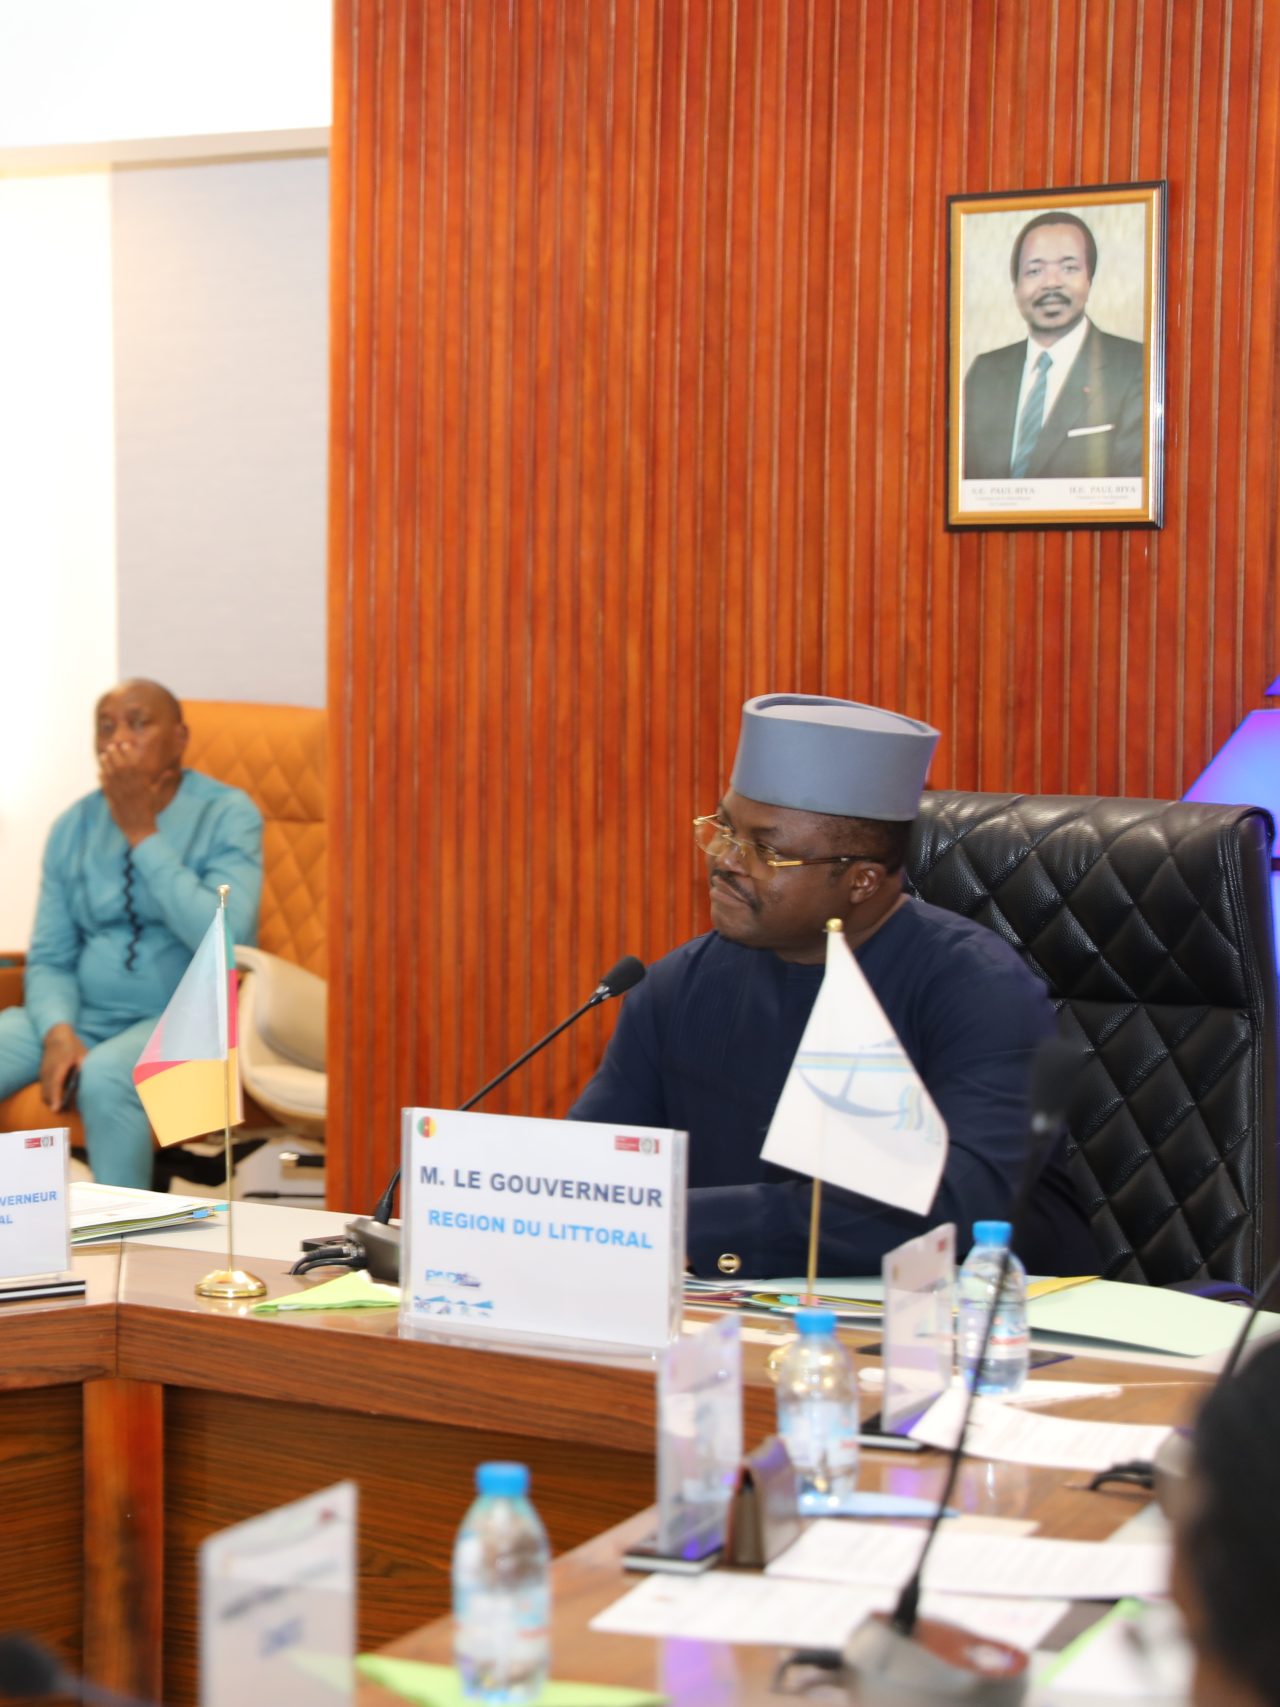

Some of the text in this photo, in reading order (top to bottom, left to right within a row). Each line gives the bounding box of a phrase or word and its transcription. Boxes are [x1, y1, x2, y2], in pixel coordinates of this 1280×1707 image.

[419, 1166, 663, 1208] M. LE GOUVERNEUR
[428, 1209, 654, 1249] REGION DU LITTORAL
